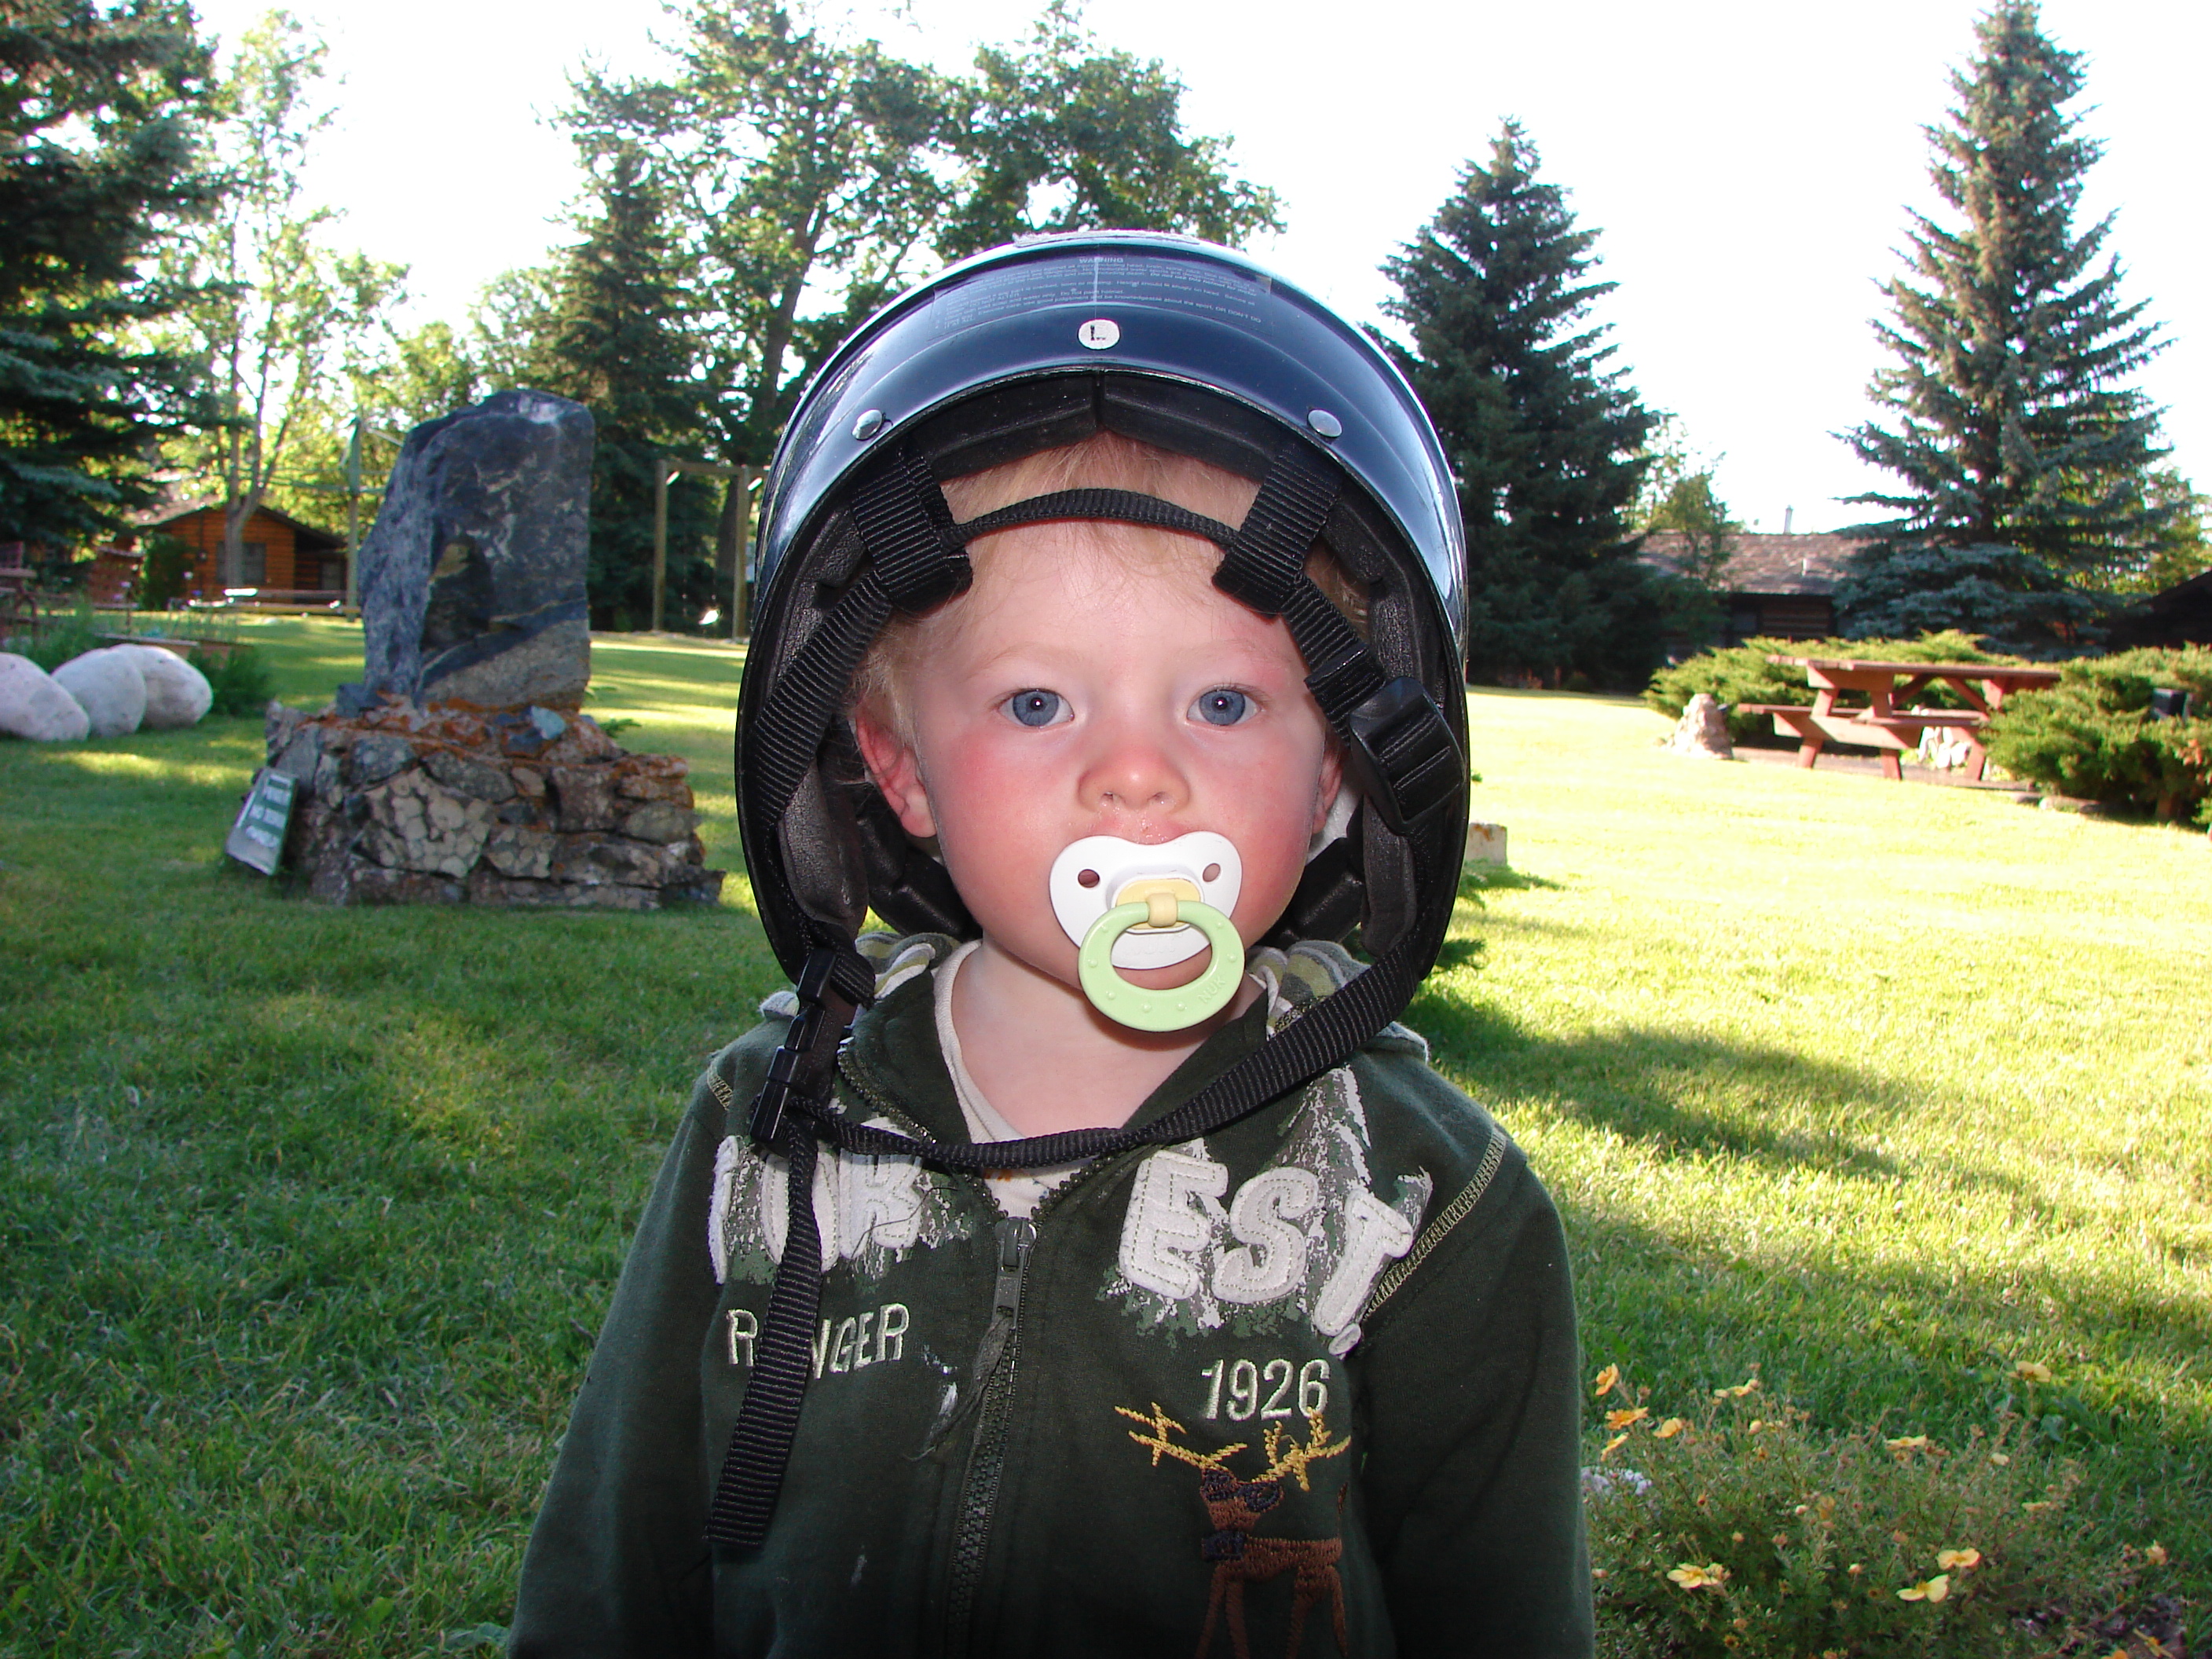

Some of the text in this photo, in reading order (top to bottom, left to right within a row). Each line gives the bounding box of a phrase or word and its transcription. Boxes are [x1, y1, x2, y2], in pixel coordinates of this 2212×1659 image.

[1197, 976, 1227, 1005] NUK
[726, 1302, 910, 1379] RNGER
[1200, 1357, 1331, 1422] 1926
